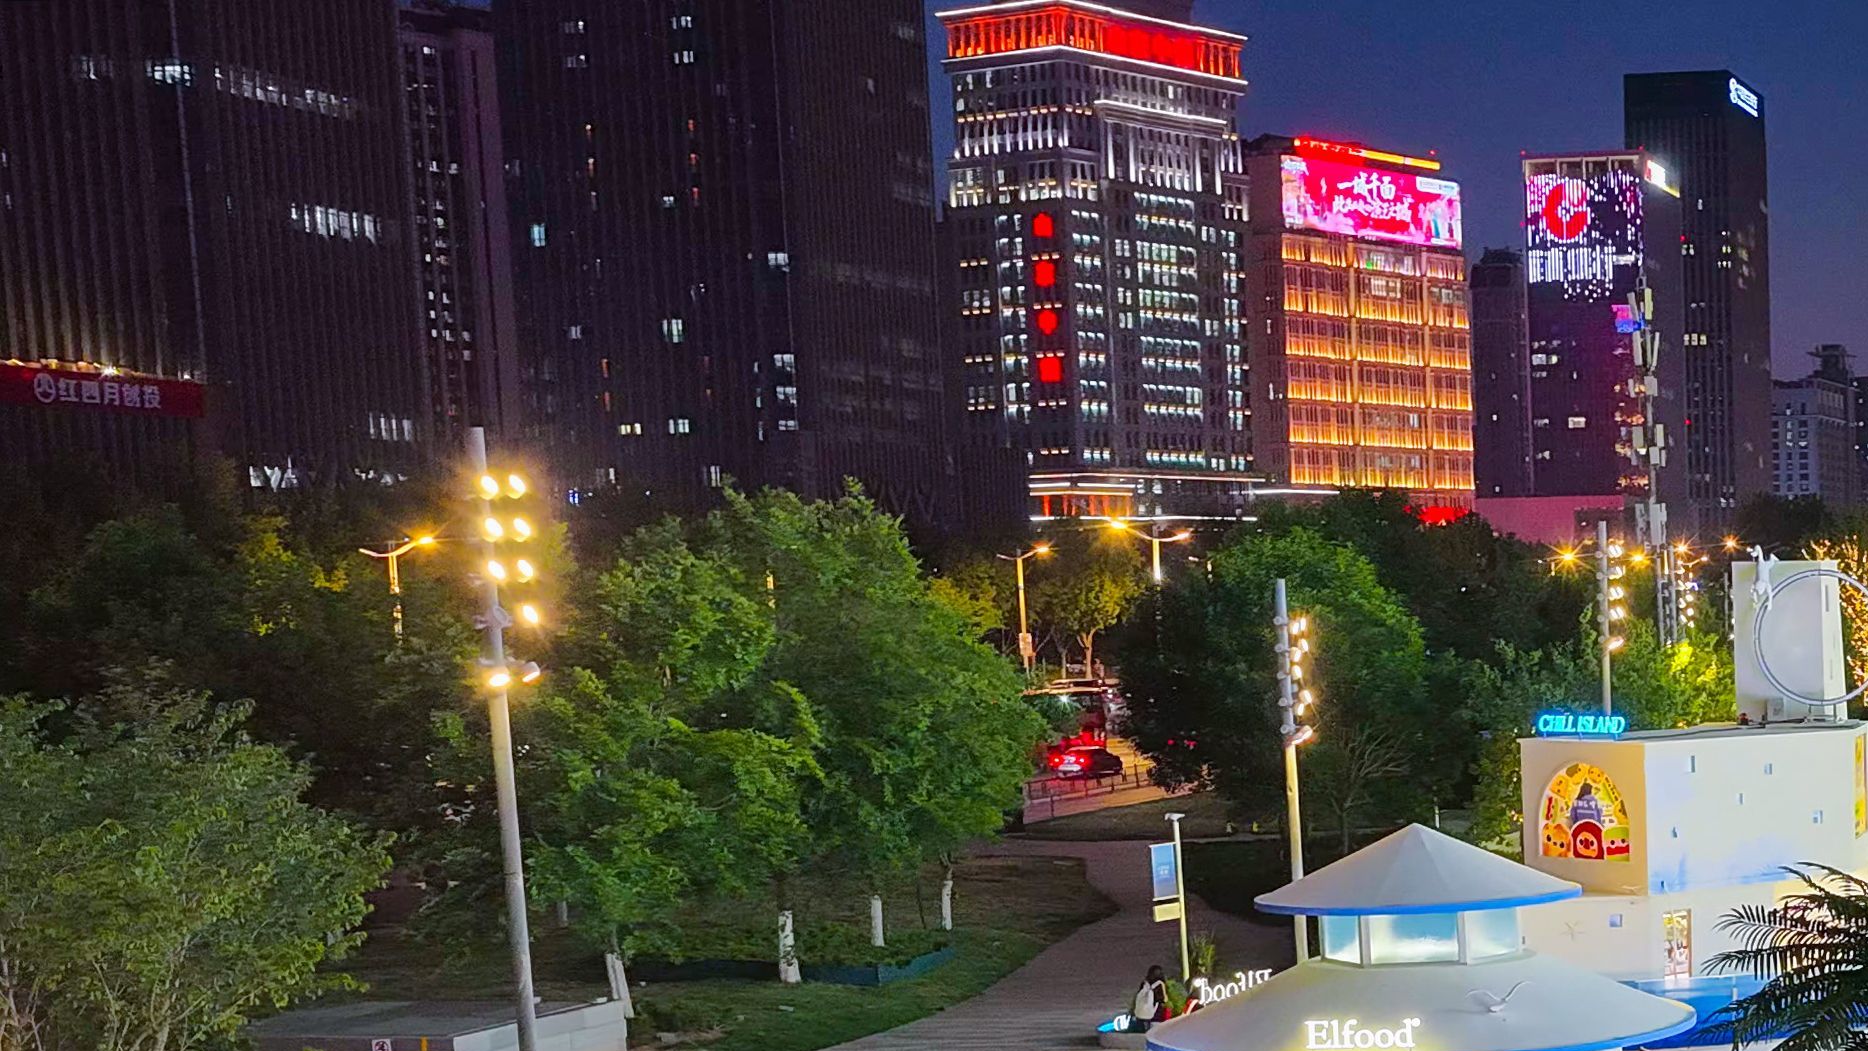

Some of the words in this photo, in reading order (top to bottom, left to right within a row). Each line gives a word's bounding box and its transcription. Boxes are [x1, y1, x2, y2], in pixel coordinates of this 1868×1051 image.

[1538, 714, 1576, 733] CHILL
[1577, 716, 1626, 734] ISLAND
[1304, 1018, 1420, 1049] Elfood
